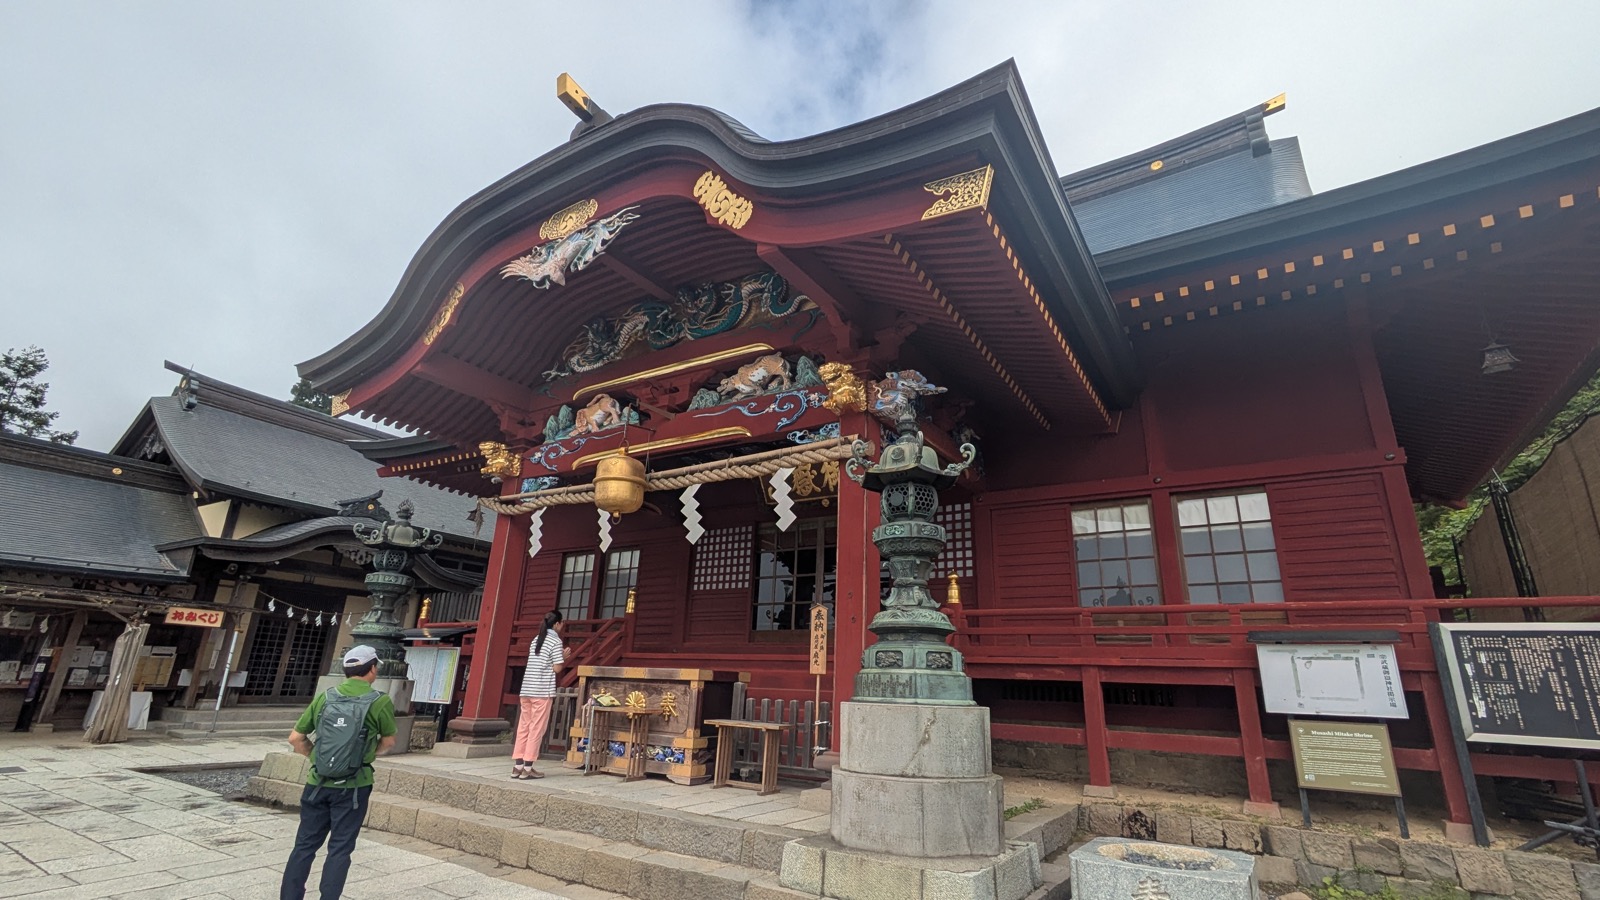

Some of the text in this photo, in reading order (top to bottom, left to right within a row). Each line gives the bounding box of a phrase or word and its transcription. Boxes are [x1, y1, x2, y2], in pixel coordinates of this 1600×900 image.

[172, 610, 219, 624] おみくじ
[814, 609, 825, 632] 奉納
